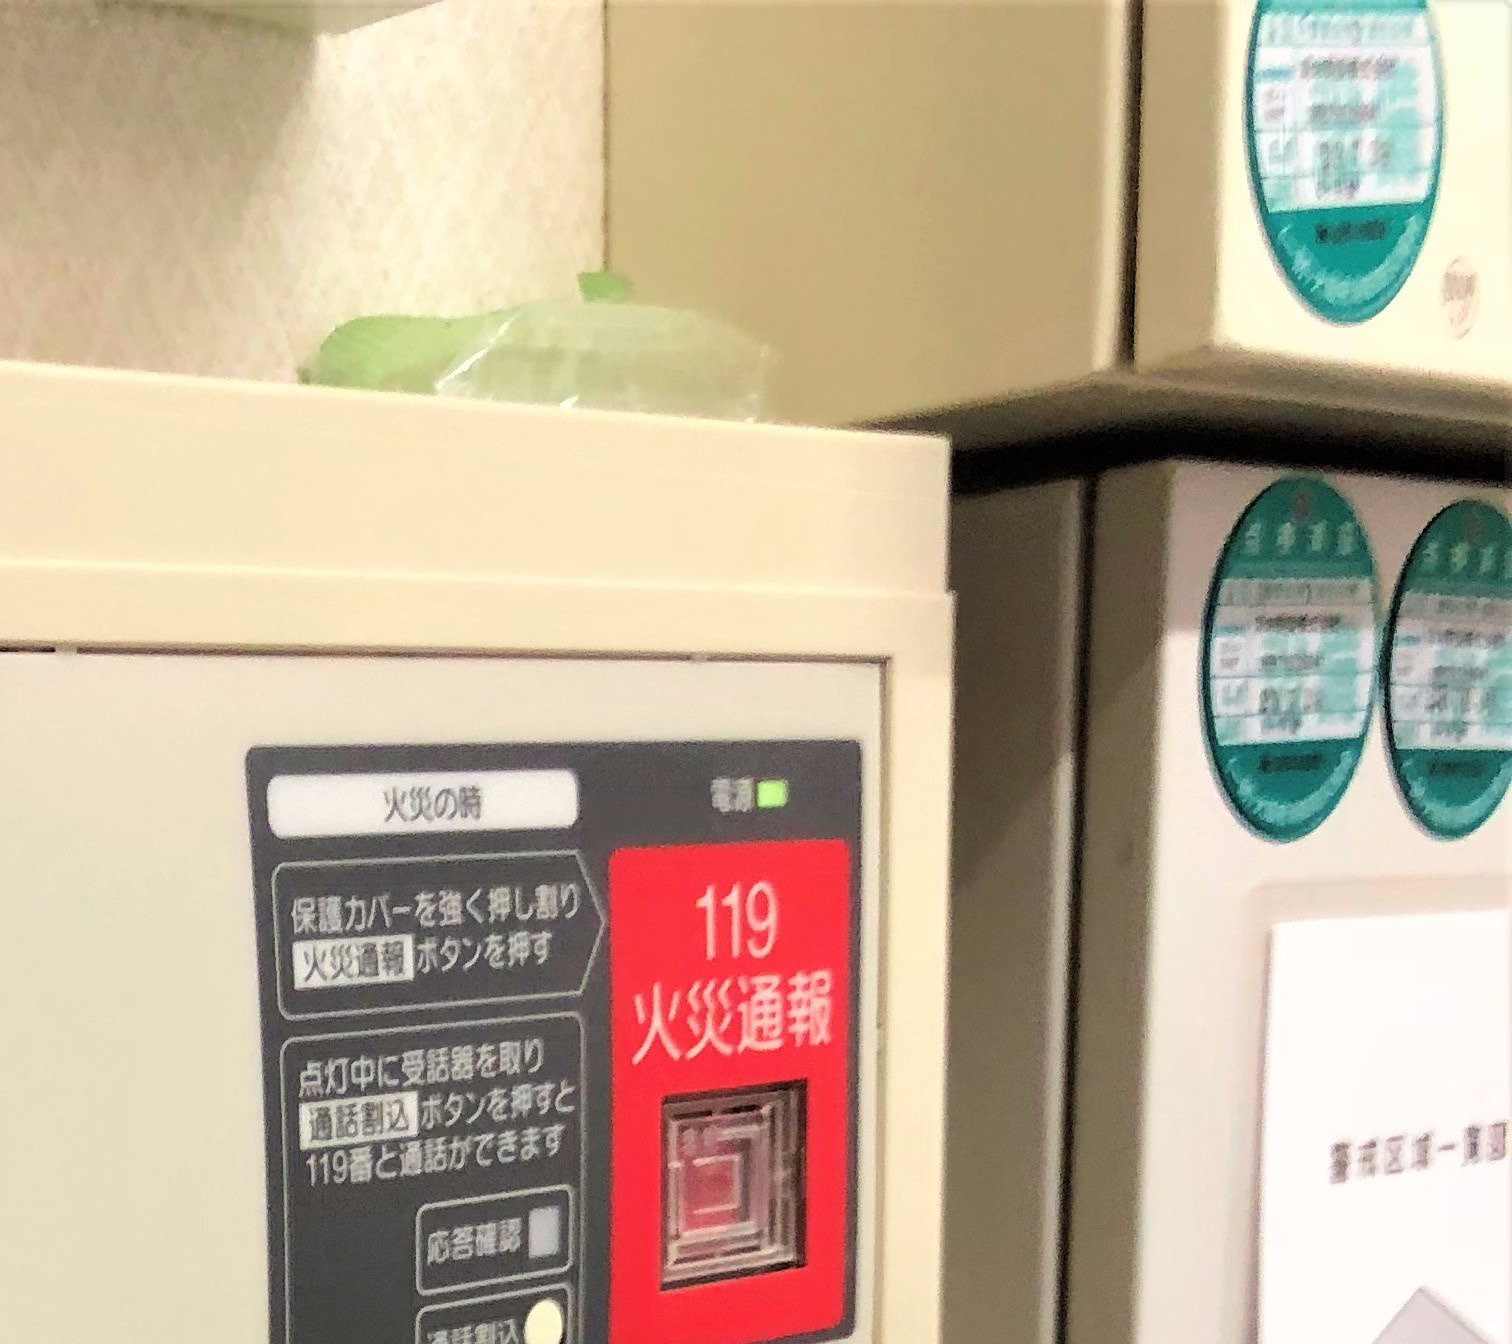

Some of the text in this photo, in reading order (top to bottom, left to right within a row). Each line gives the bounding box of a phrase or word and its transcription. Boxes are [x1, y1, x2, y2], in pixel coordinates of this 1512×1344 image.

[384, 786, 483, 824] 火災の時
[291, 882, 581, 935] 保護カバーを強く押し割り
[696, 881, 779, 961] 119
[632, 970, 834, 1066] 火災通報
[299, 1038, 546, 1097] 点灯中に受話器を取り
[306, 1124, 565, 1188] 119番と通話ができます
[426, 1217, 523, 1265] 応答確認
